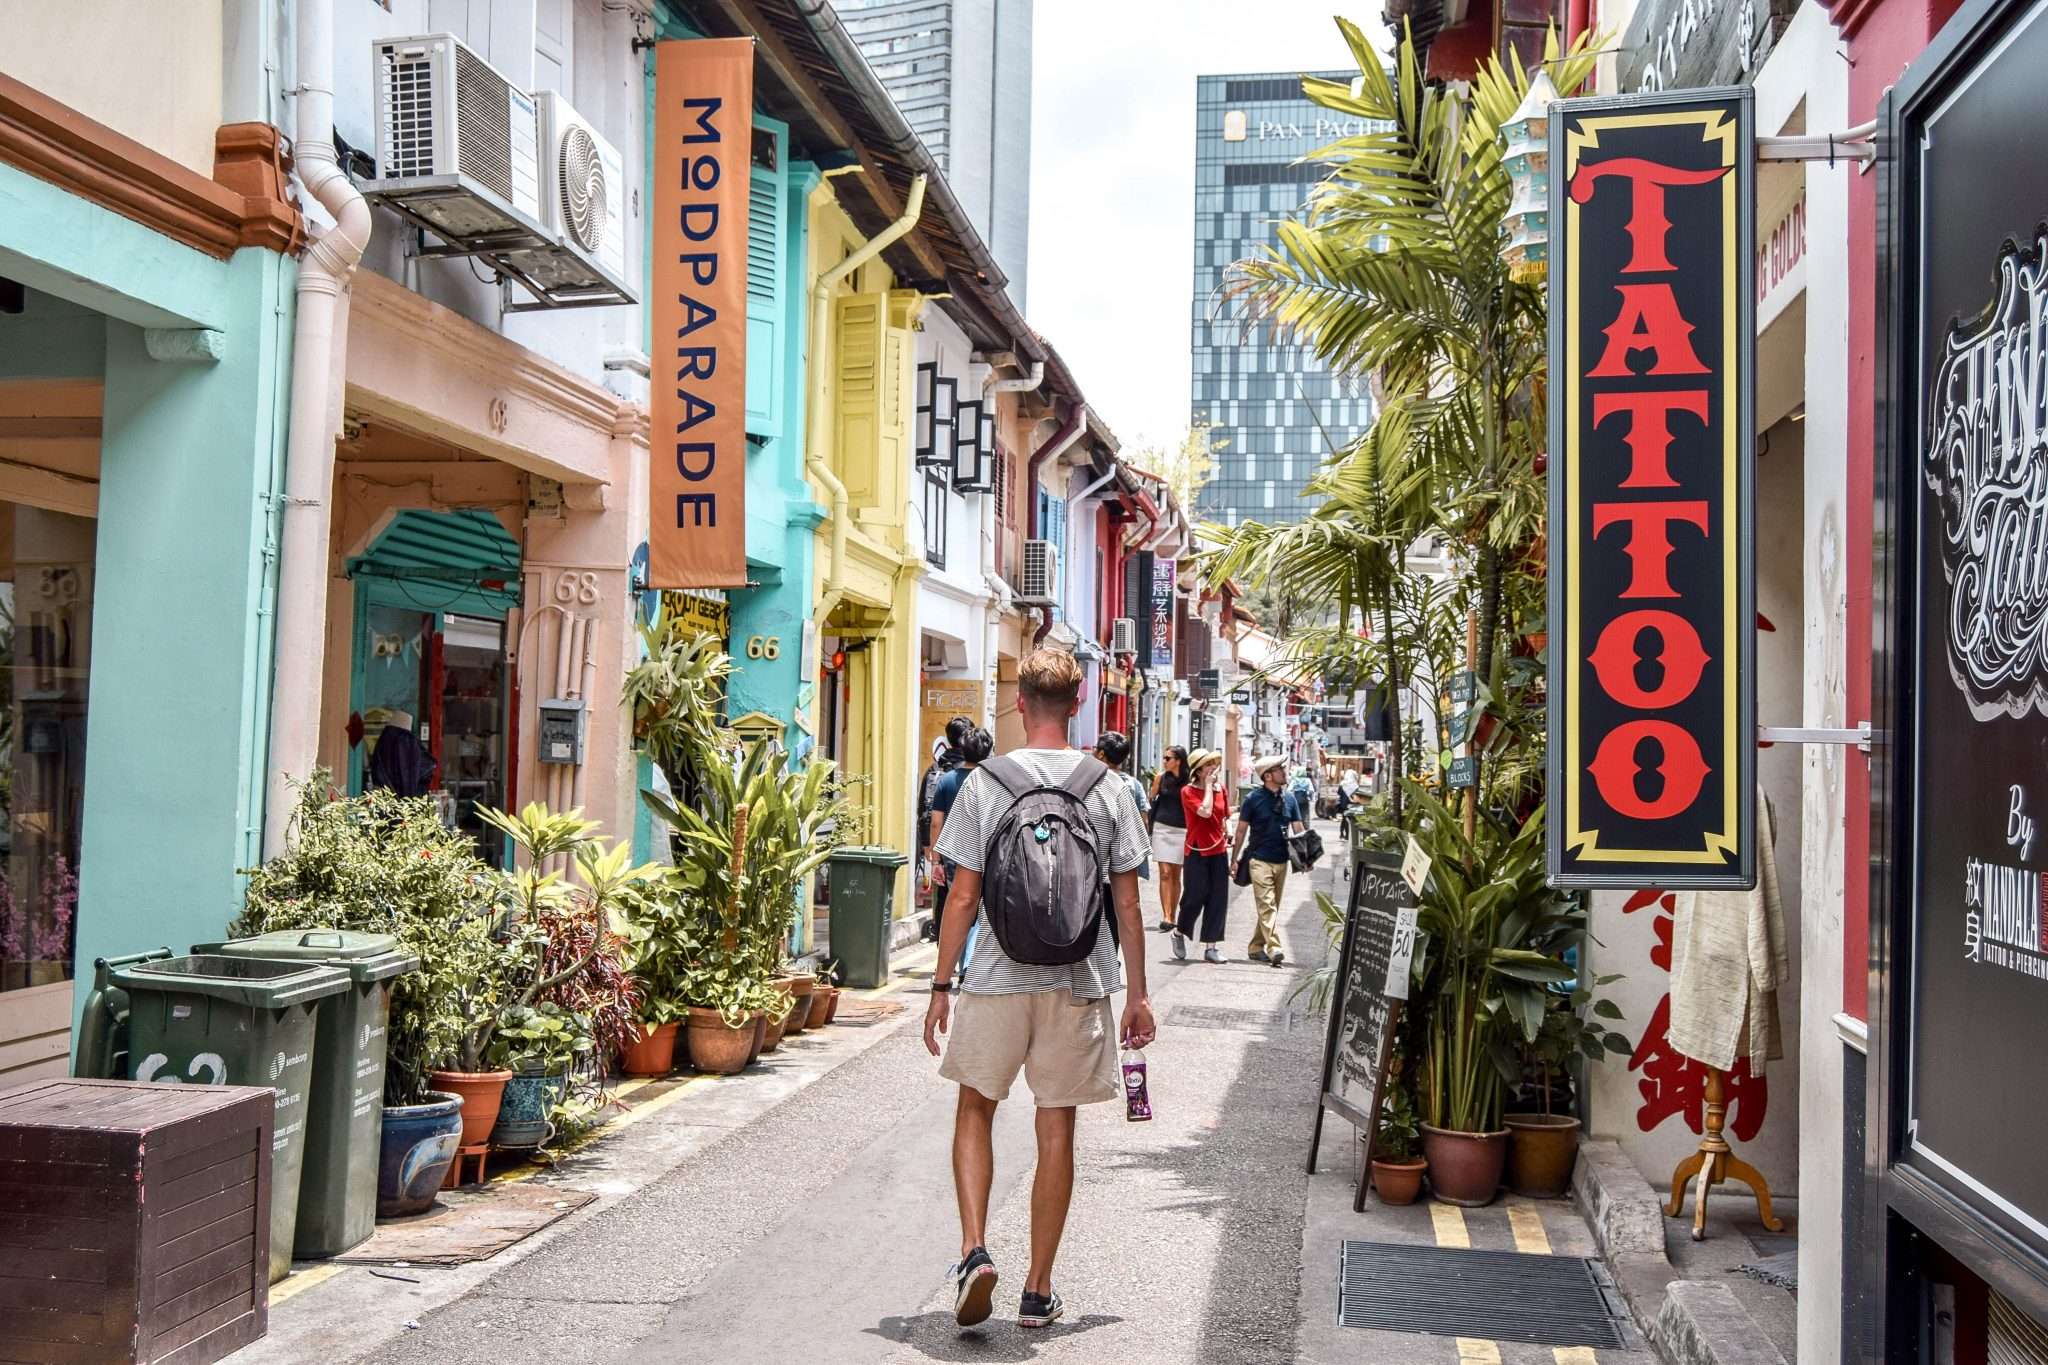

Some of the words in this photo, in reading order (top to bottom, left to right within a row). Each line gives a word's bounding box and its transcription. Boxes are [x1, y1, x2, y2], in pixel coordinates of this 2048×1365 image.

[1258, 121, 1303, 141] PAN
[675, 97, 722, 529] MODPARADE
[489, 397, 507, 433] 68
[1570, 157, 1735, 820] TATTOO
[555, 571, 599, 604] 68
[747, 635, 780, 660] 66
[2007, 784, 2034, 861] By
[1983, 862, 2039, 952] MANDALA
[1983, 942, 2007, 967] TATTOO
[2009, 954, 2014, 969] &
